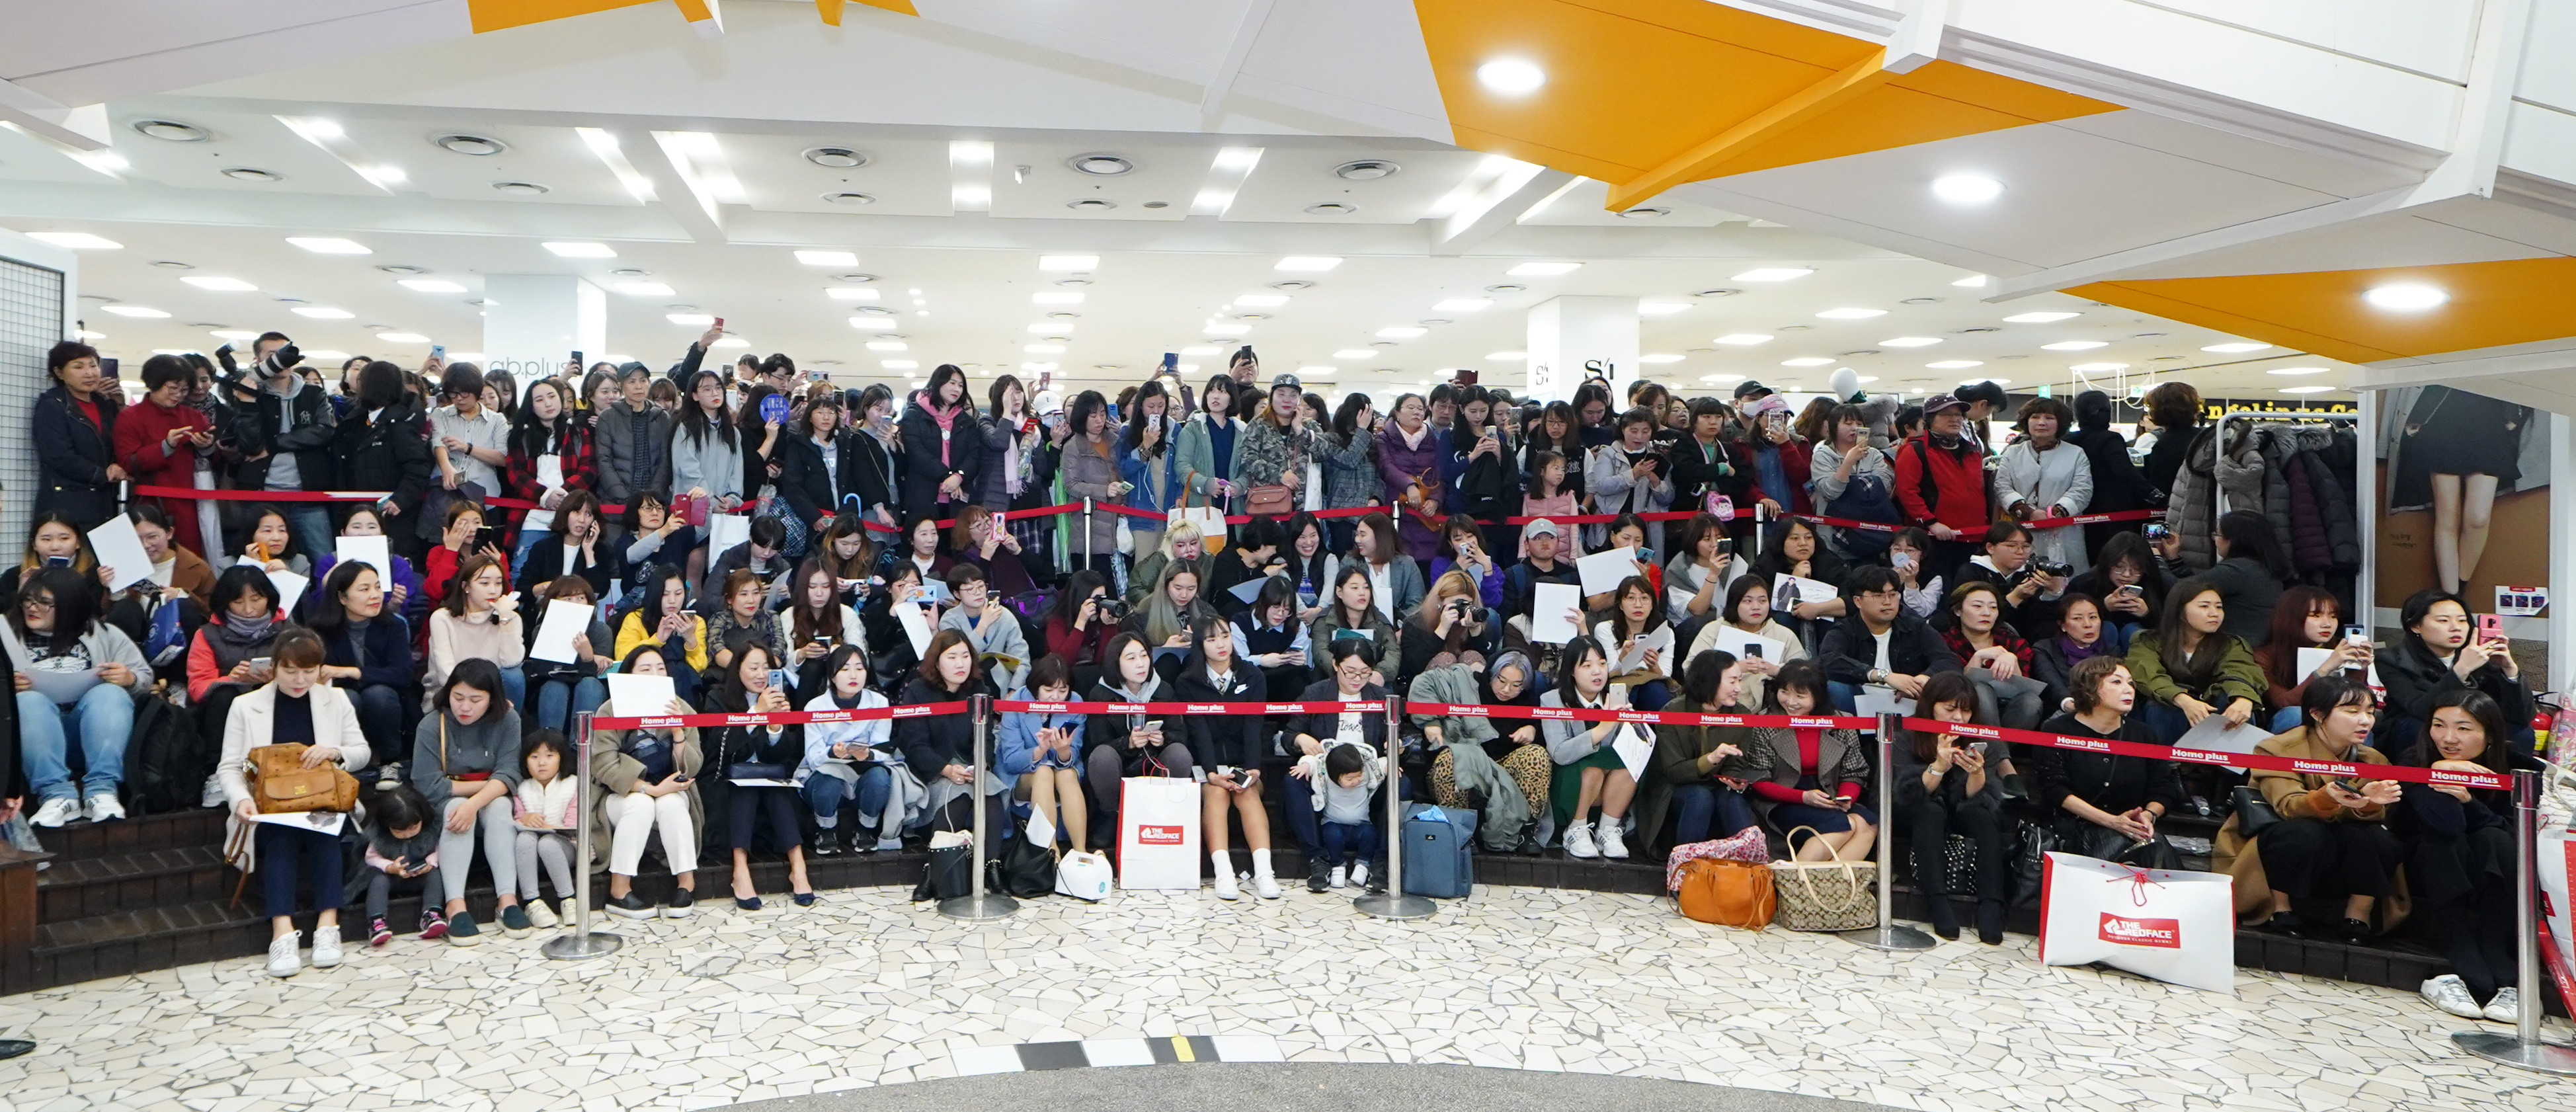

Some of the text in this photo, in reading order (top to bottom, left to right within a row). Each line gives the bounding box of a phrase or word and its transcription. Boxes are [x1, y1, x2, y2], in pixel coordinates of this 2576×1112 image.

[1951, 725, 1999, 736] Home plus
[2056, 736, 2109, 748] Home plus
[2172, 749, 2229, 762] Home plus
[2294, 760, 2356, 773] Home plus
[2431, 771, 2499, 785] Home plus
[2119, 920, 2141, 929] THE
[2123, 928, 2172, 939] REDFACE
